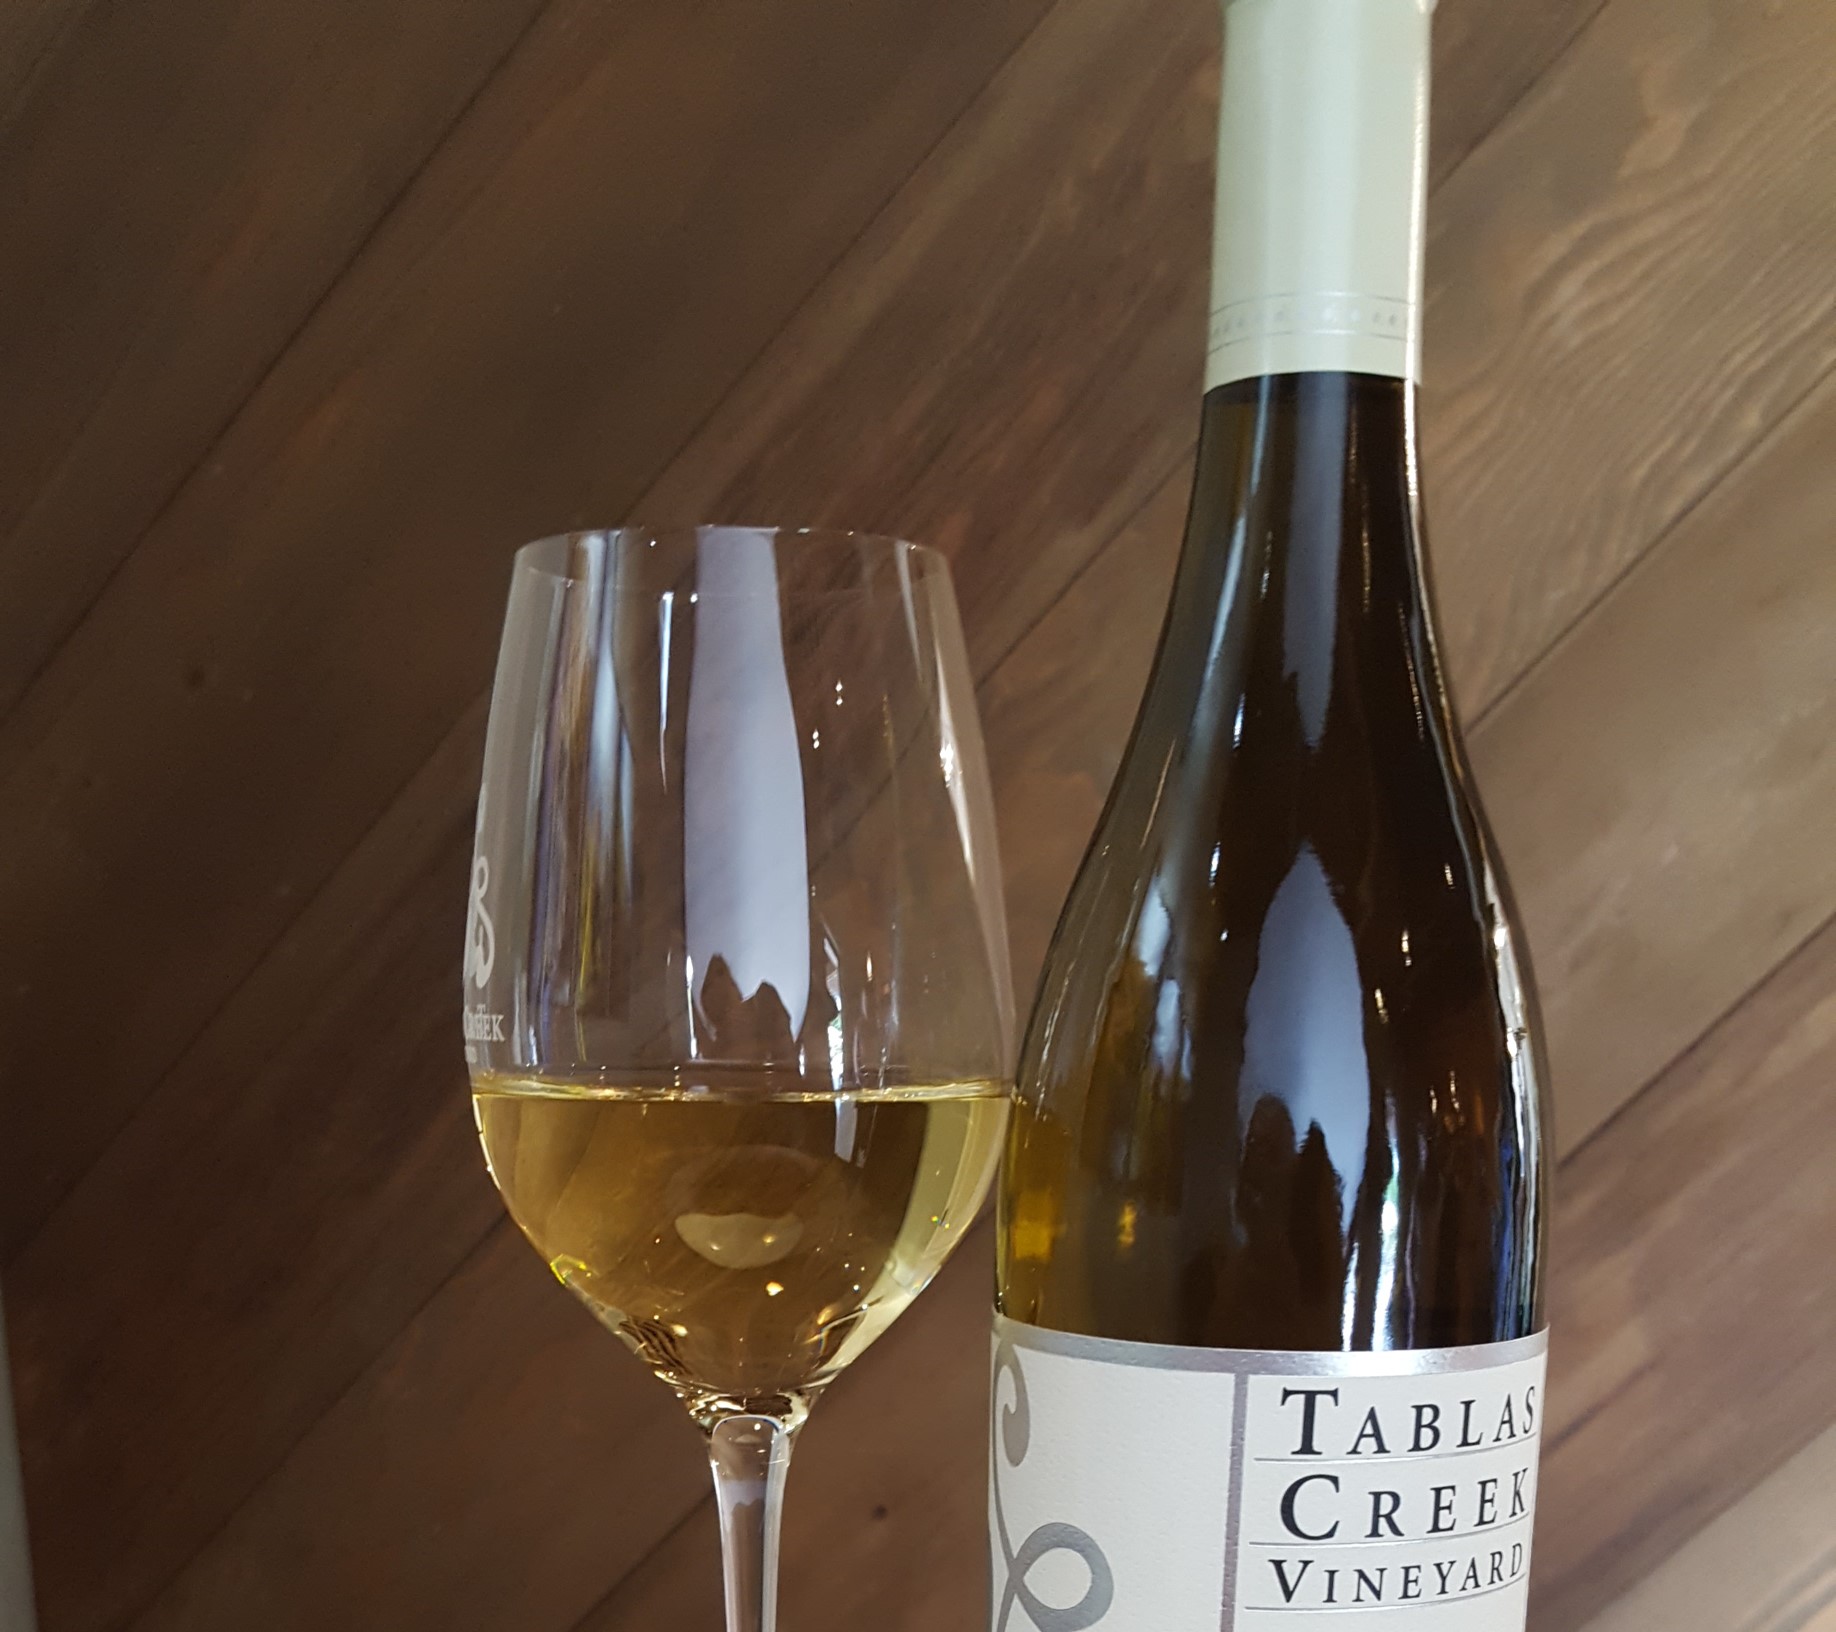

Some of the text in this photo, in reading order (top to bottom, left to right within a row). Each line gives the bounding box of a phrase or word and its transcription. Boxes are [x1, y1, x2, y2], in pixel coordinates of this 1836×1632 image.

[1280, 1386, 1535, 1456] TABLAS
[1280, 1467, 1529, 1541] CREEK
[1268, 1543, 1523, 1603] VINEYARD
